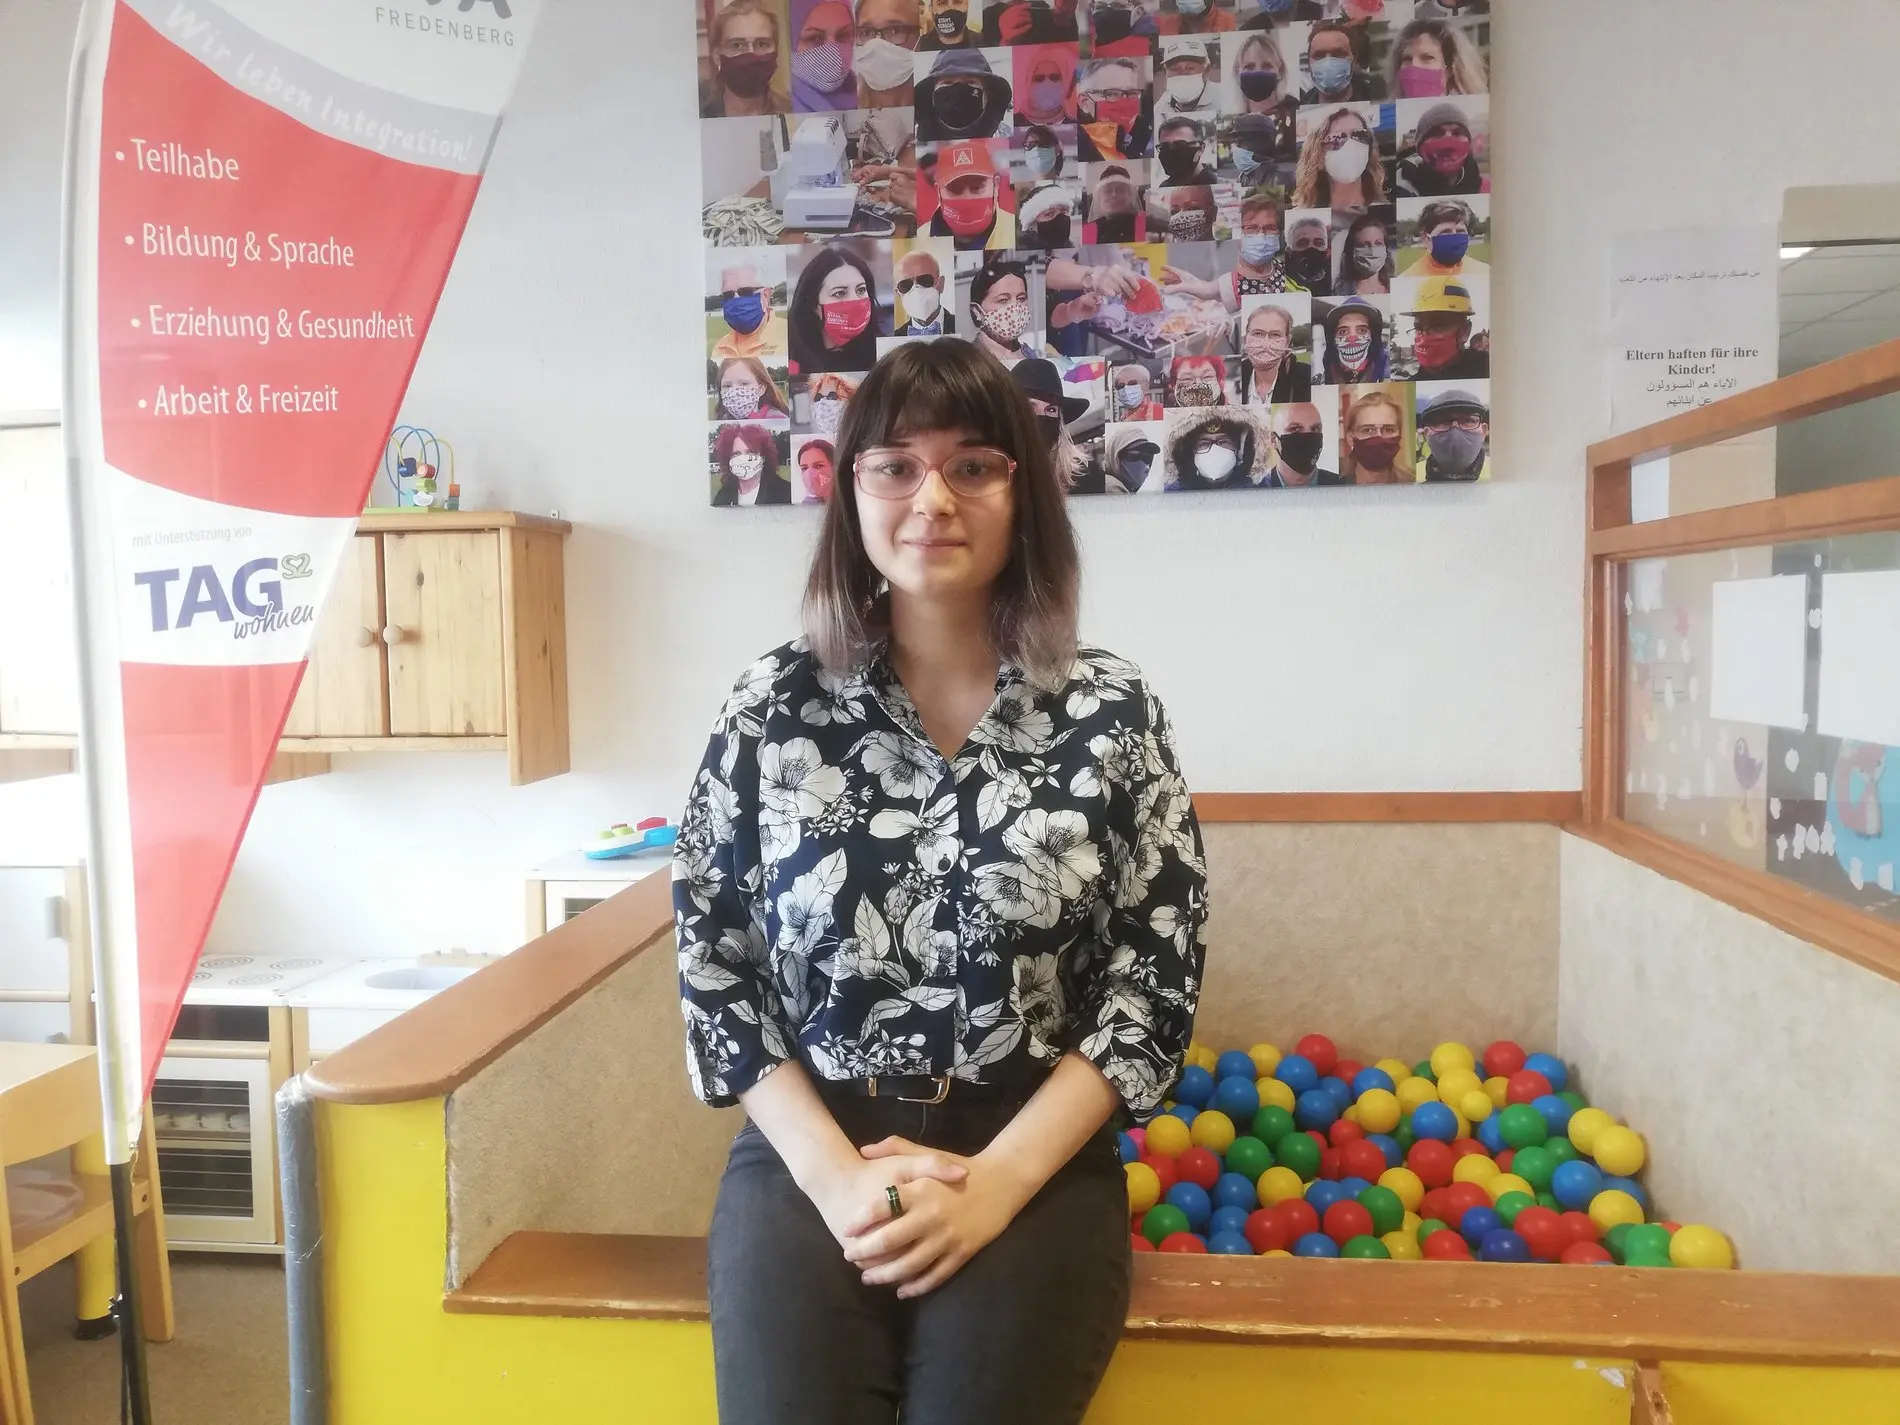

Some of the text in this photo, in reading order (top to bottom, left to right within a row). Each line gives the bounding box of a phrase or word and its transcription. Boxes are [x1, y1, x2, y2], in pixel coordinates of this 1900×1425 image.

[375, 7, 514, 47] FREDENBERG
[166, 1, 231, 61] Wir
[320, 94, 475, 162] Integration!
[130, 138, 240, 180] Teilhabe
[143, 222, 354, 269] Bildung & Sprache
[149, 304, 415, 344] Erziehung & Gesundheit
[1626, 347, 1759, 360] Eltern haften für ihre
[1668, 364, 1716, 375] Kinder!
[154, 384, 339, 416] Arbeit & Freizeit
[132, 533, 152, 547] mit
[233, 526, 252, 538] von
[134, 557, 284, 632] TAG
[234, 601, 314, 639] wohnen
